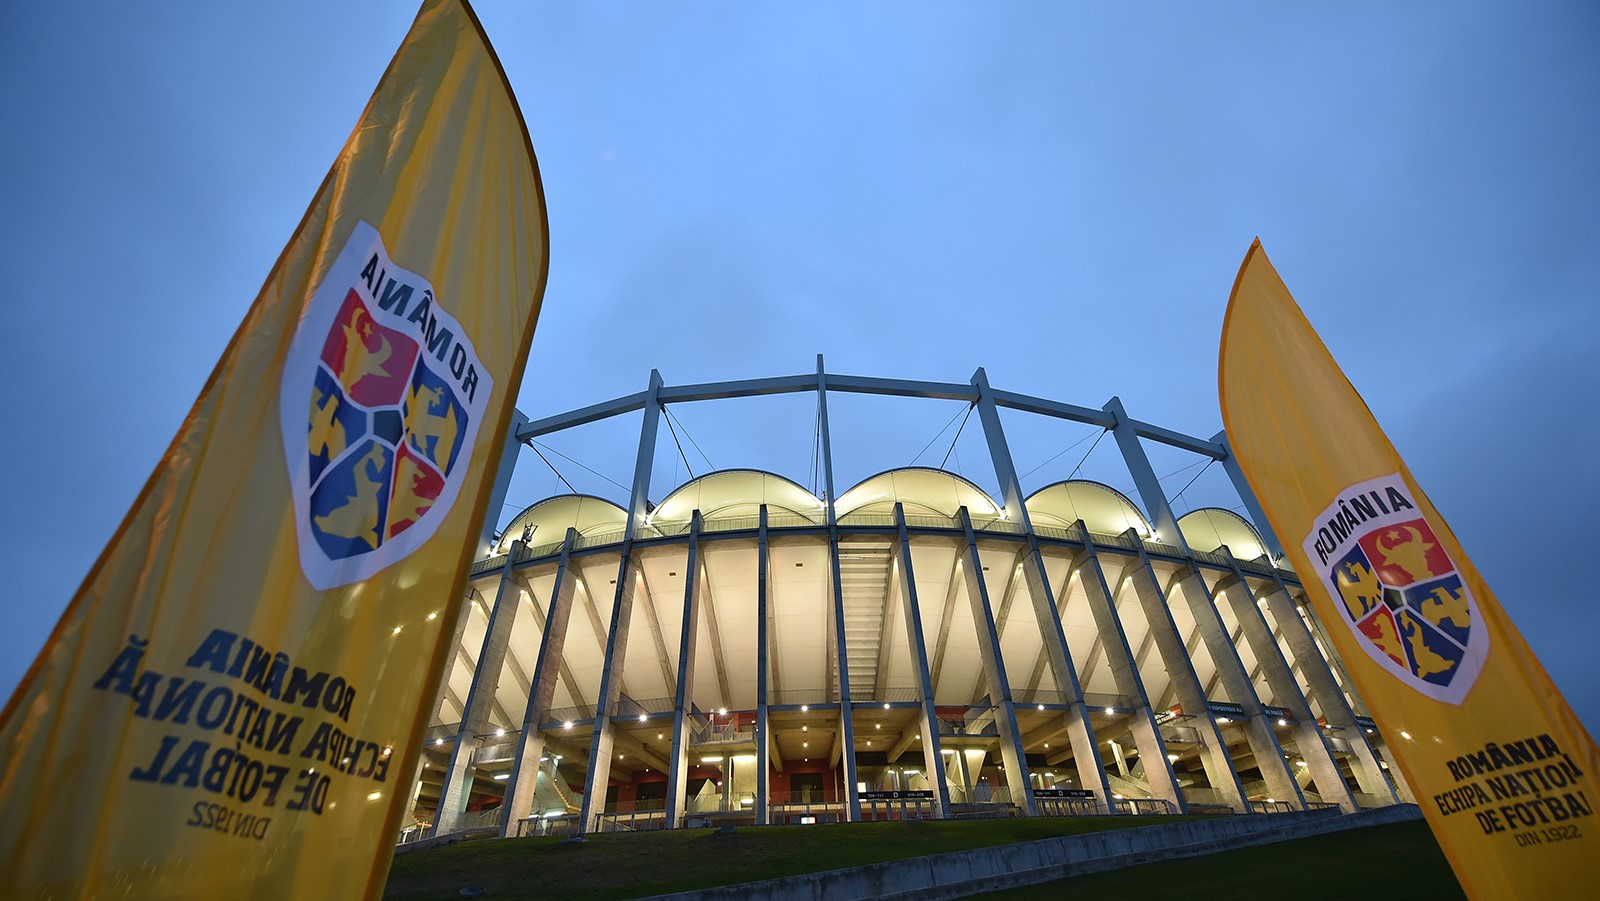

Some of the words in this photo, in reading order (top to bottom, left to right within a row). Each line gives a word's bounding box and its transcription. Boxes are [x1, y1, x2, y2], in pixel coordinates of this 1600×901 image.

[1314, 486, 1414, 567] ROMÂNIA
[1446, 733, 1562, 782] ROMÂNIA
[1433, 782, 1493, 816] ECHIPA
[1474, 808, 1506, 835] DE
[1514, 830, 1542, 848] DIN
[1541, 824, 1582, 844] 1922
